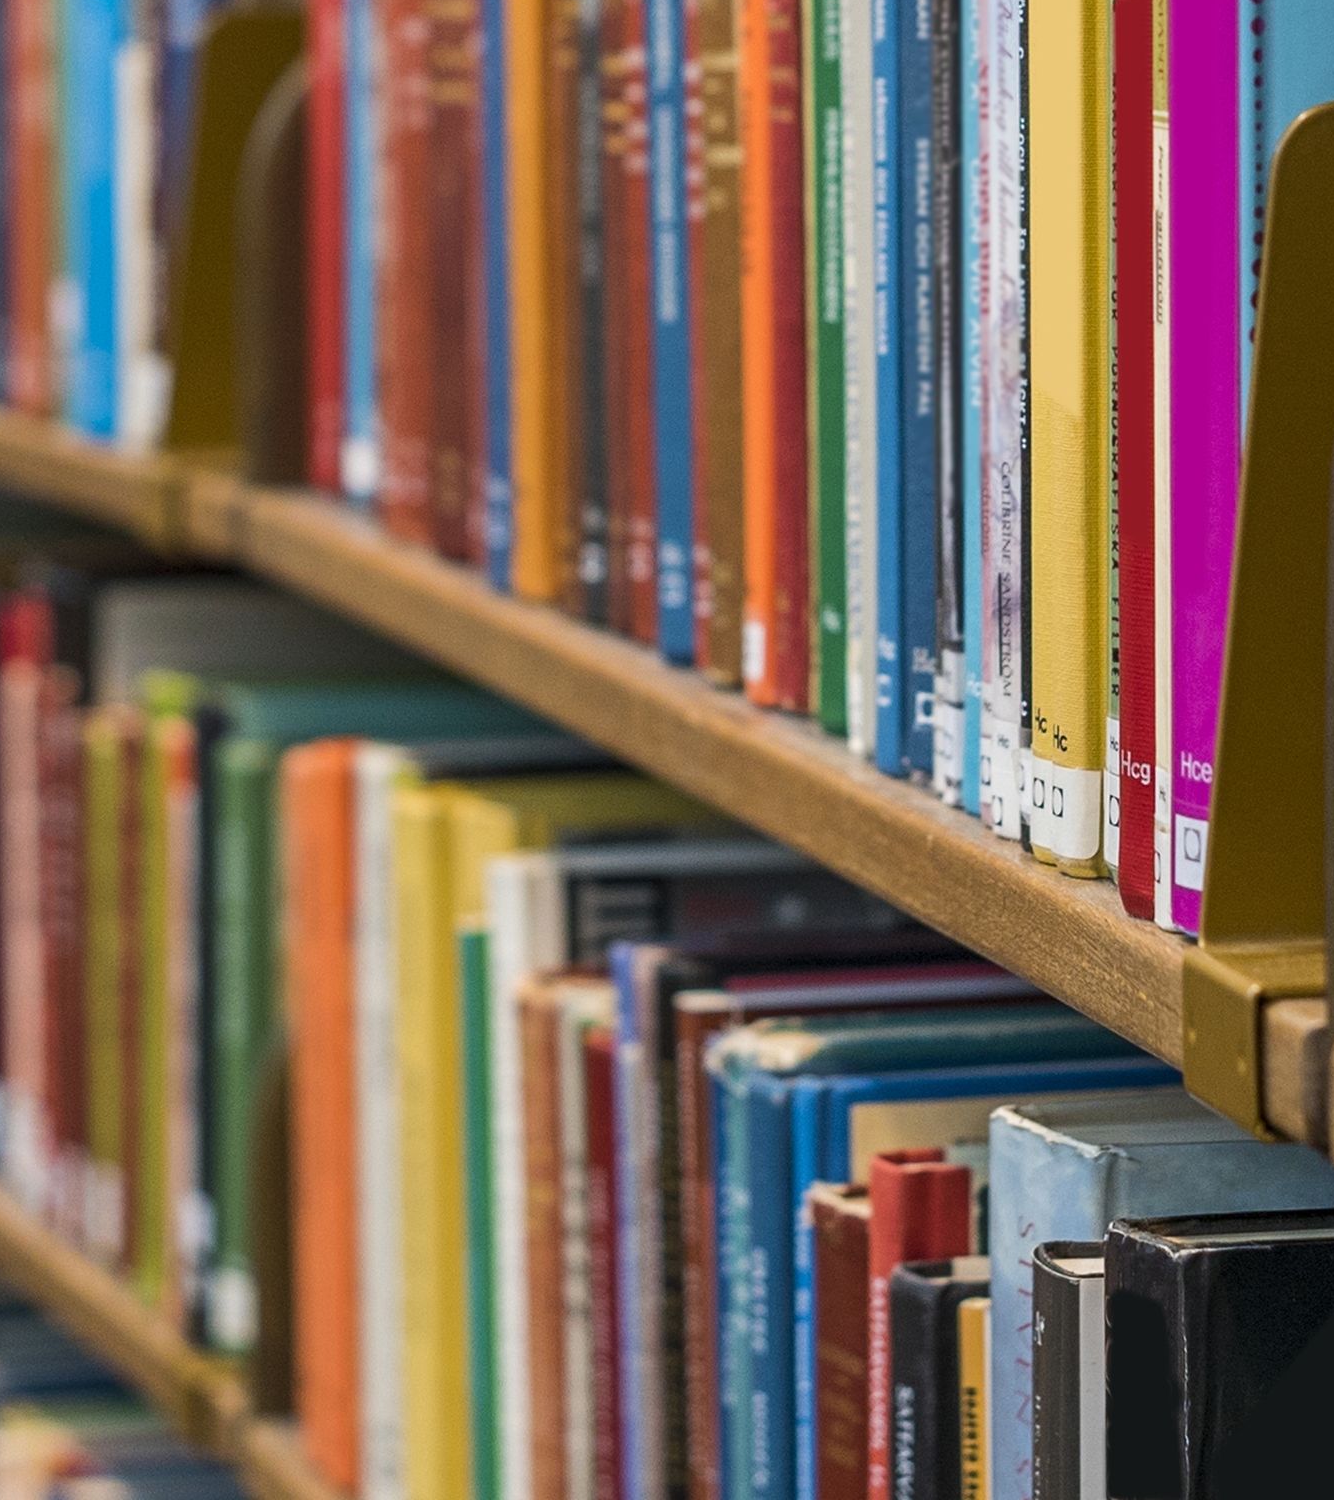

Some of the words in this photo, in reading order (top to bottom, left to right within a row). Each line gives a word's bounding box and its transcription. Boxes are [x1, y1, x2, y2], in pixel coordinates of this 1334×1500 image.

[1000, 461, 1012, 565] COLIBRINE
[1000, 572, 1014, 697] SANDSTRÖM
[1035, 706, 1048, 734] Hc
[1052, 725, 1068, 751] Hc
[1121, 749, 1151, 785] Hcg
[1180, 750, 1213, 784] Hce
